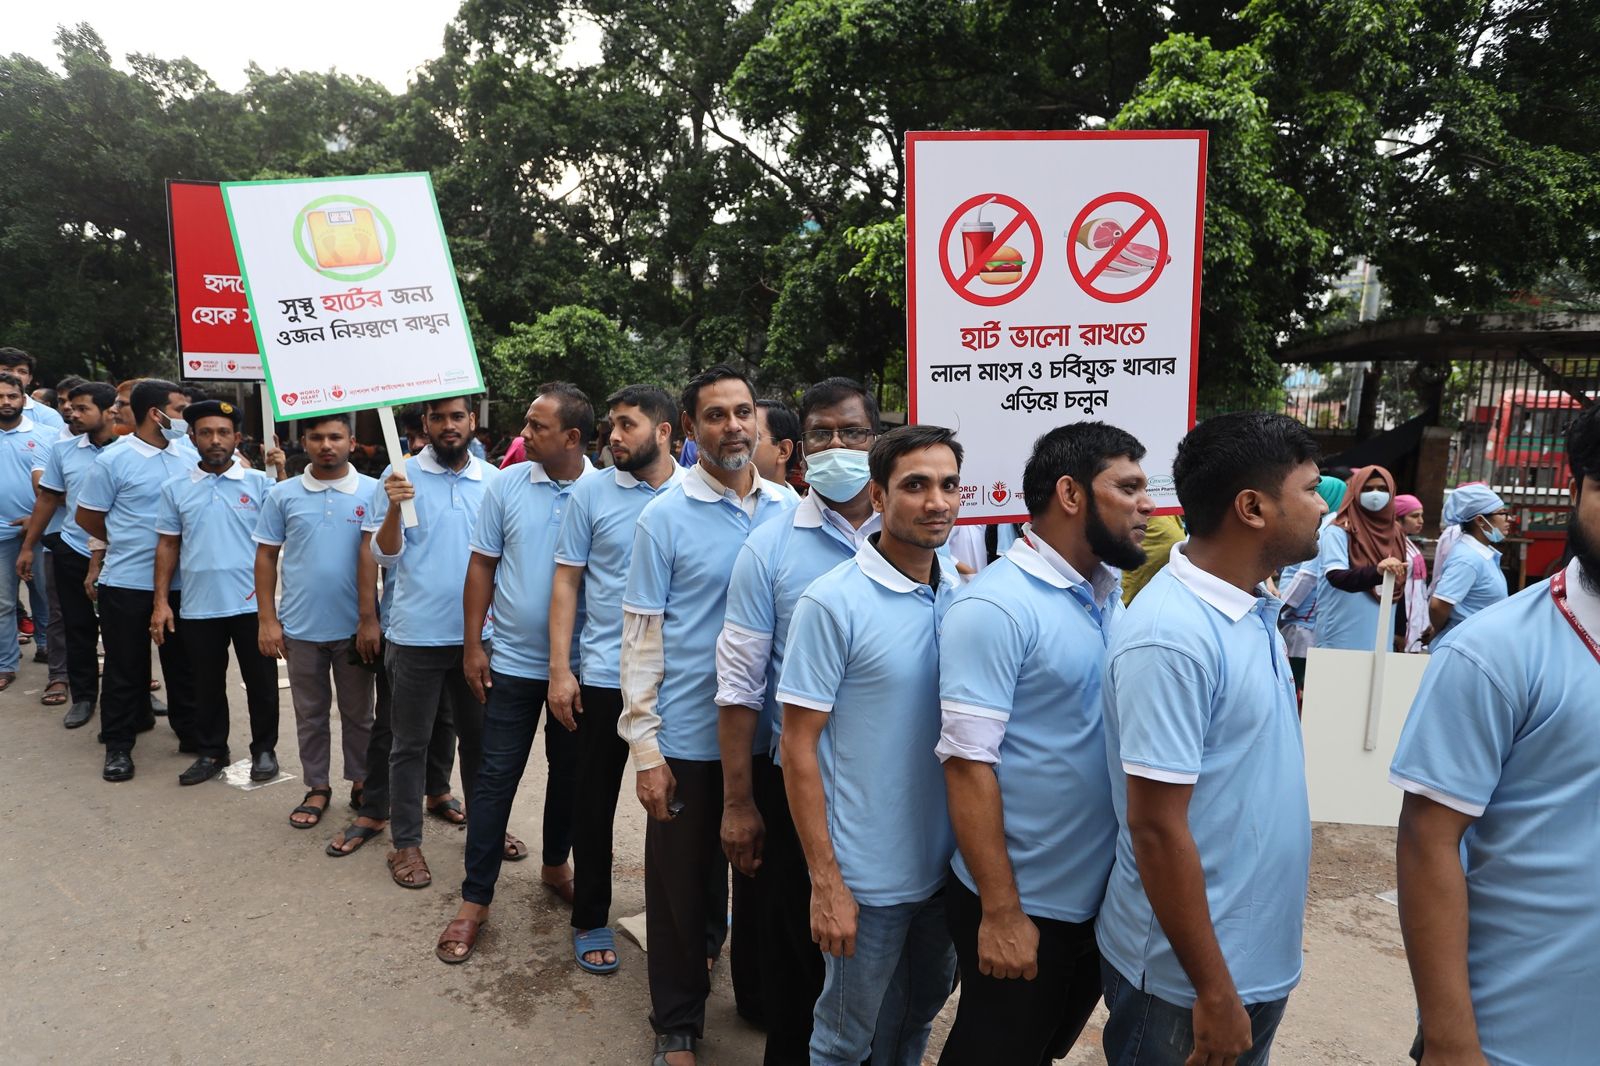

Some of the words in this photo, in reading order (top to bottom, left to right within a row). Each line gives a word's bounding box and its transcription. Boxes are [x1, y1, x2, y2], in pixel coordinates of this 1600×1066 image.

[191, 306, 238, 326] হোক
[278, 297, 318, 323] সুস্থ
[320, 287, 384, 312] হার্টের
[388, 285, 434, 304] জন্য
[277, 327, 325, 345] ওজন
[330, 319, 398, 339] নিয়ন্ত্রণে
[403, 313, 451, 334] রাখুন
[960, 321, 1001, 351] হার্ট
[1008, 325, 1071, 349] ভালো
[1078, 322, 1147, 346] রাখতে
[930, 363, 972, 383] লাল
[977, 362, 1023, 383] মাংস
[1028, 361, 1042, 380] ও
[1049, 353, 1117, 384] চর্বিযুক্ত
[1123, 357, 1176, 376] খাবার
[1001, 385, 1058, 413] এড়িয়ে
[1064, 389, 1109, 415] চলুন
[959, 492, 975, 500] ART
